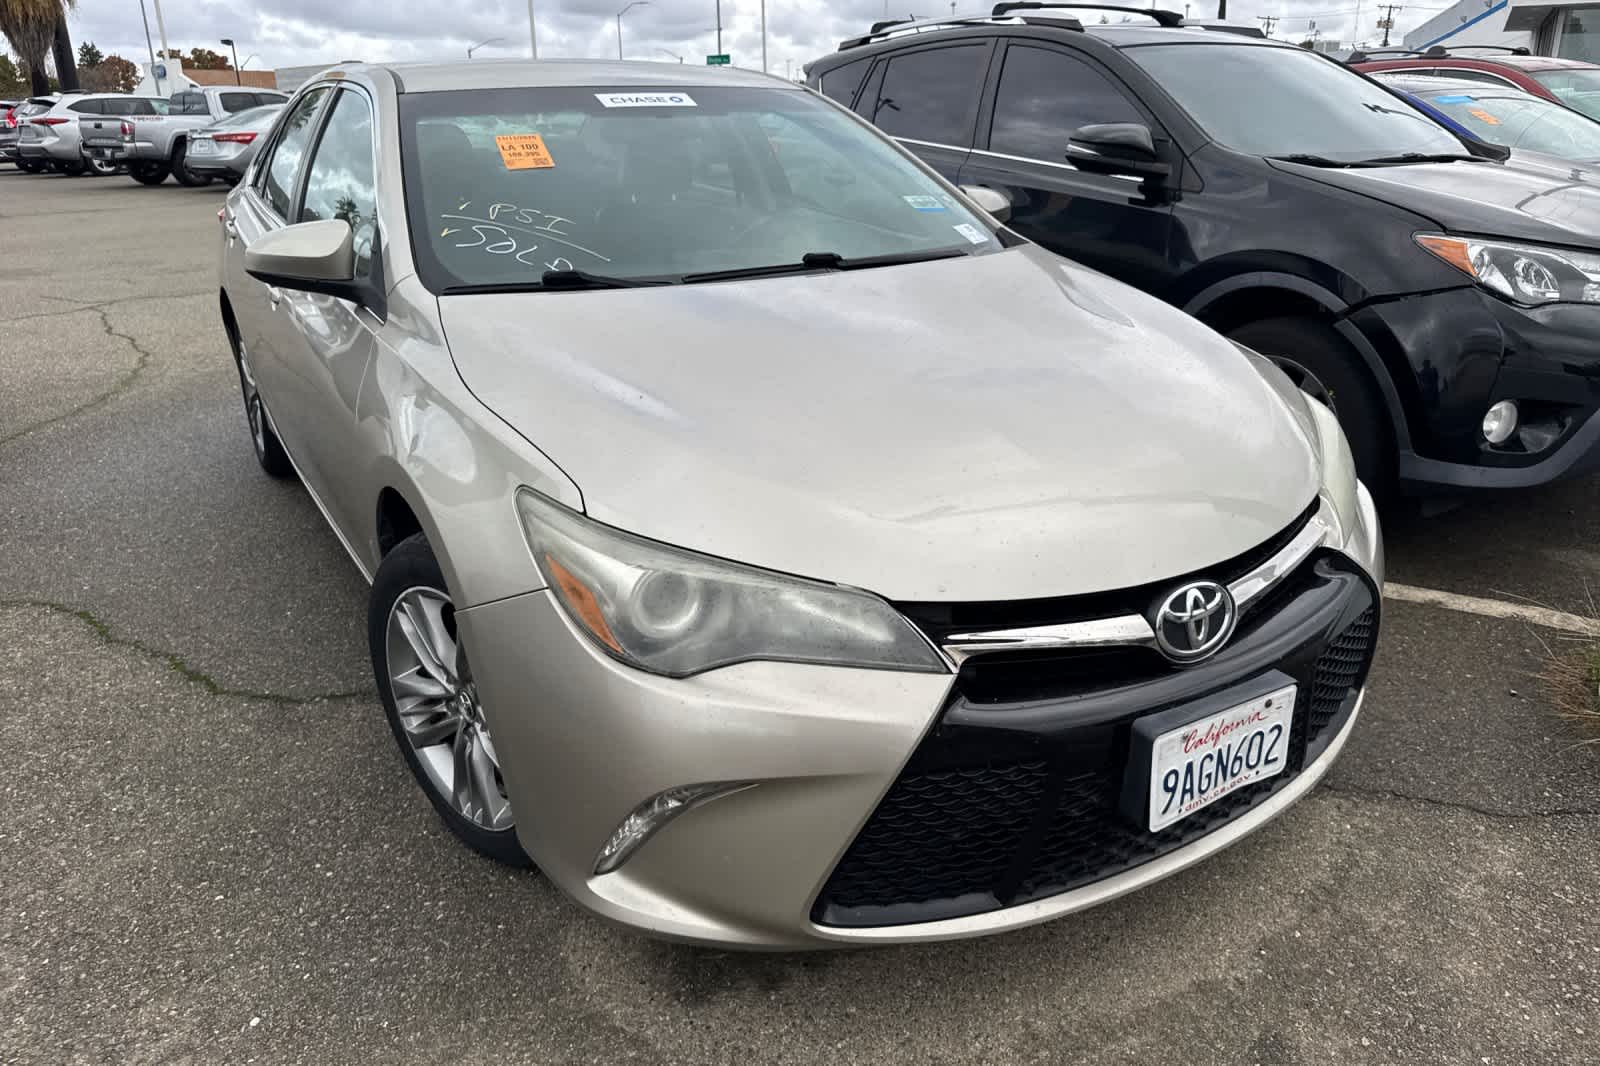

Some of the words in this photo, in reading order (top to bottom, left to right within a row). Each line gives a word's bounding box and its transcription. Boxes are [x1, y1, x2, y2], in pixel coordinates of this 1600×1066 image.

[610, 96, 668, 105] CHASE
[501, 144, 517, 152] LA
[521, 143, 540, 151] 100
[489, 203, 577, 236] PSI
[1184, 709, 1270, 754] California
[1162, 723, 1283, 815] 9AGN602
[1184, 773, 1252, 812] dmv.ca.gov
